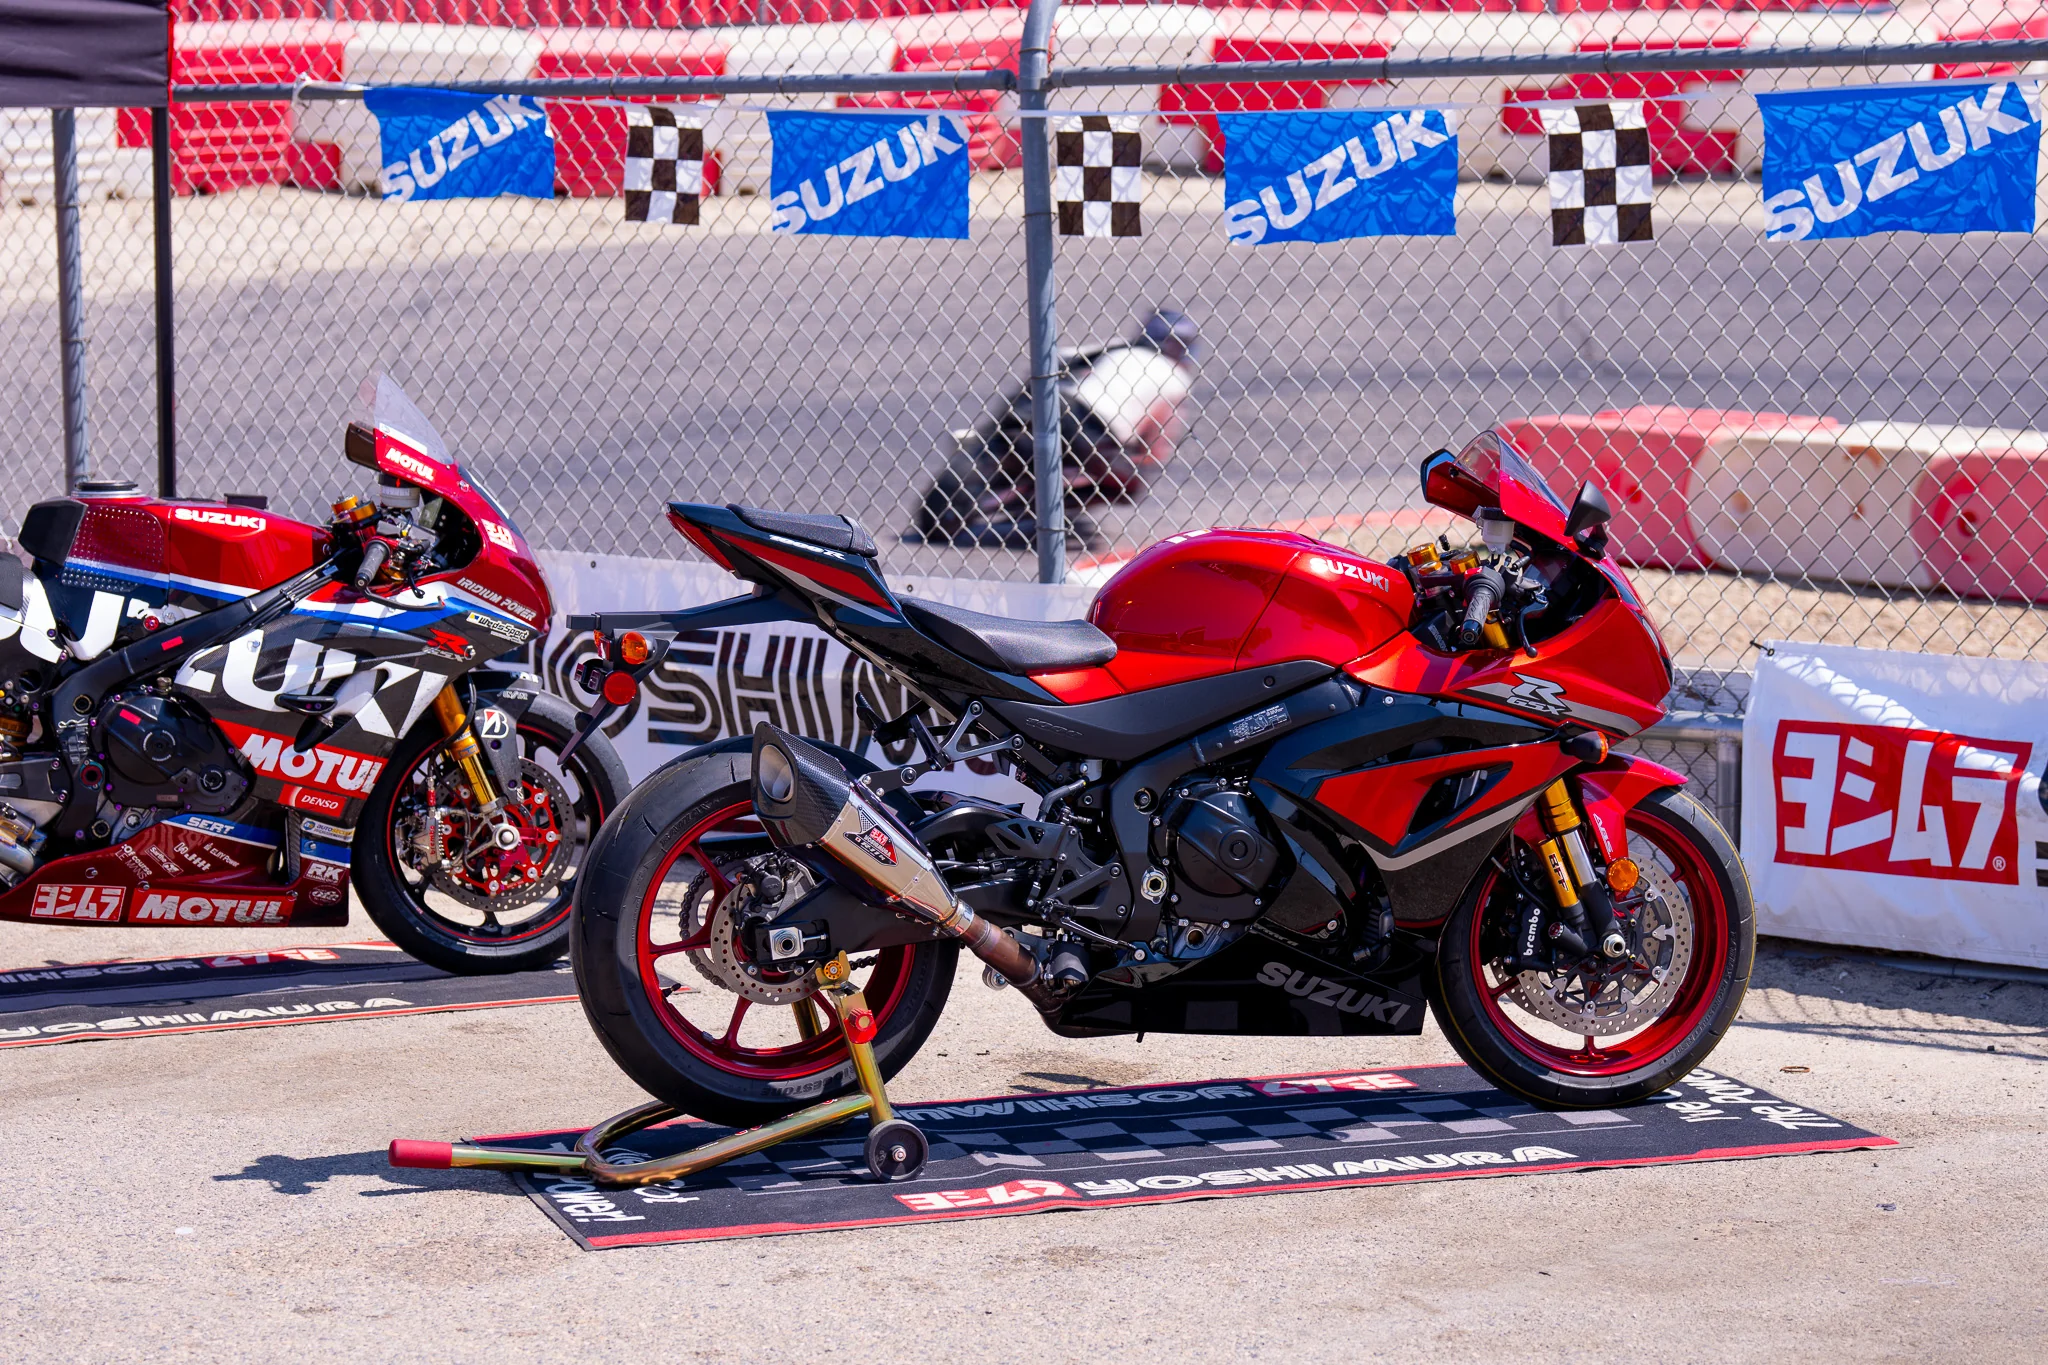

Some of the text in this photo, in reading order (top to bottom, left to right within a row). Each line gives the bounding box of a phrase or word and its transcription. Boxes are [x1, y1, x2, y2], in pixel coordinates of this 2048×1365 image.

[385, 447, 435, 481] MOTUL
[174, 508, 266, 531] SUZUKI
[1309, 557, 1390, 593] SUZUKI
[456, 577, 537, 621] IRIDIUM POWER
[478, 616, 529, 640] WedsSport
[0, 567, 448, 741] UUKI
[1506, 697, 1566, 715] GSX
[247, 733, 383, 795] MOTUL
[301, 795, 339, 810] DENSO
[1781, 731, 2018, 870] ヨシムラ
[187, 817, 234, 835] SERT
[115, 849, 148, 880] LE MANS
[307, 862, 343, 881] RK
[1549, 853, 1569, 892] BFF
[36, 887, 123, 919] ヨシムラ
[136, 894, 284, 923] MOTUL
[1522, 907, 1541, 956] brembo
[1256, 961, 1411, 1026] SUZUKI
[0, 997, 414, 1038] YOSHIMURA
[1680, 1068, 1783, 1104] Powe
[1075, 1146, 1577, 1196] YOSHIMURA
